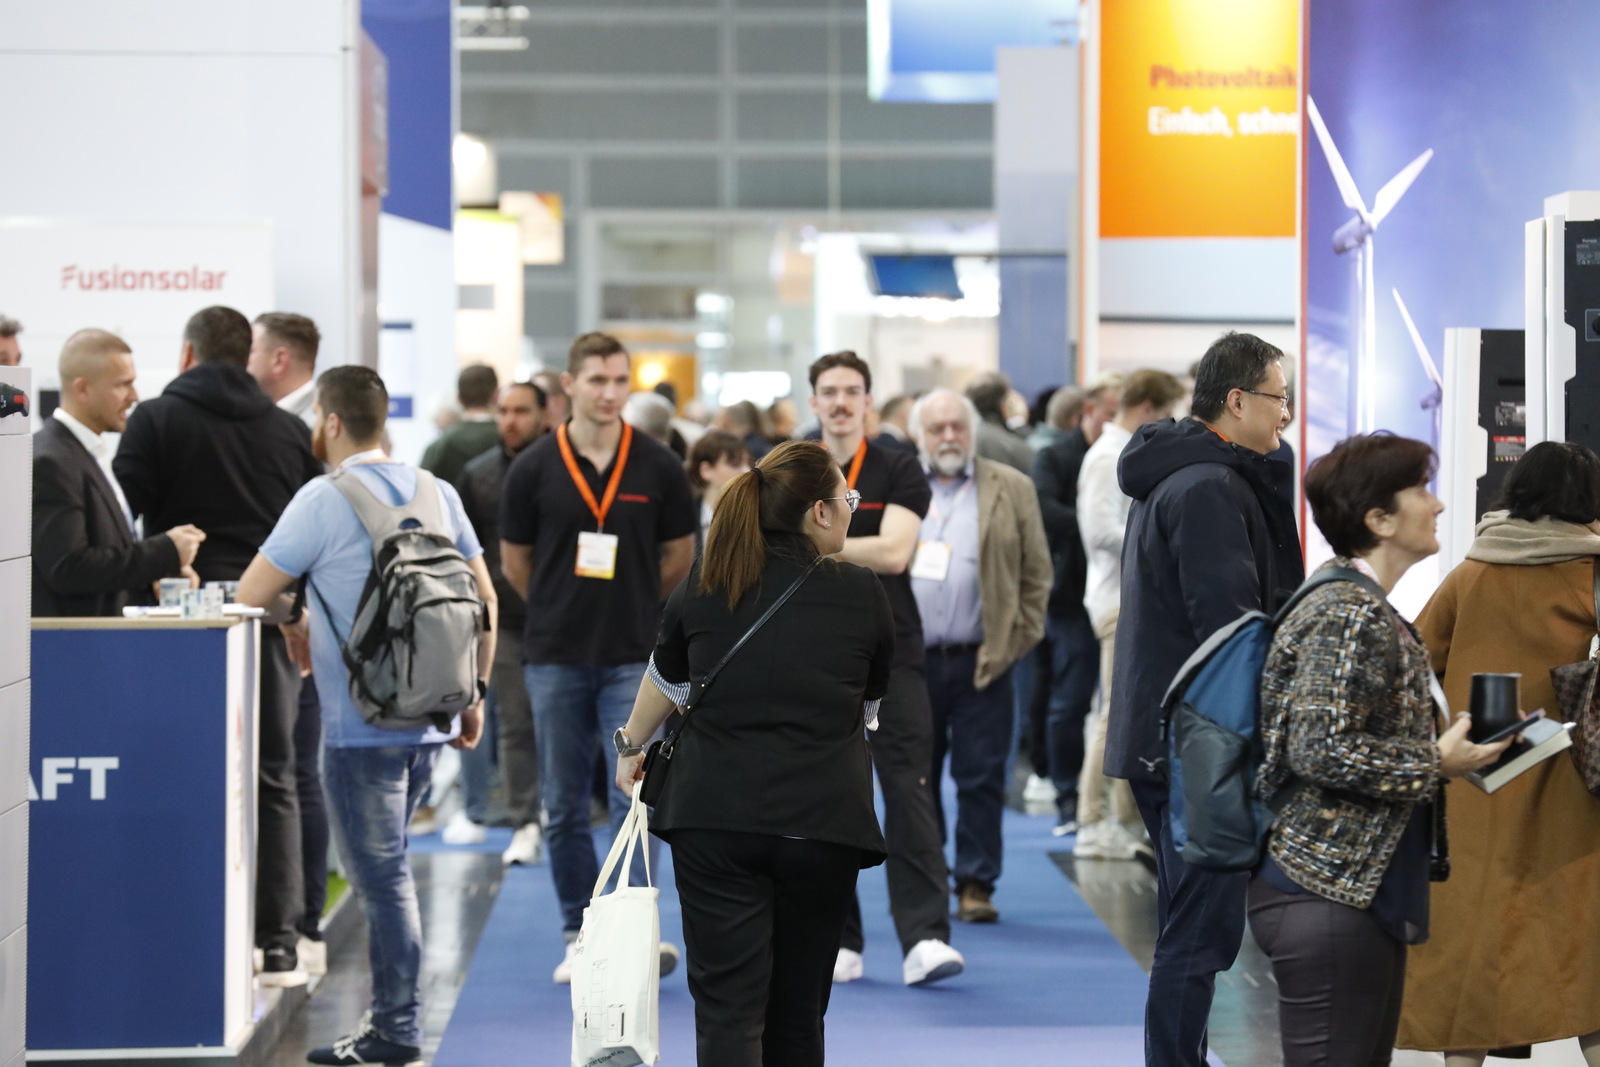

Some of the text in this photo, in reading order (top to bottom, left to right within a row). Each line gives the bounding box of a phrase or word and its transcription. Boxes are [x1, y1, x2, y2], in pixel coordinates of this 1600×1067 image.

[1150, 64, 1297, 89] Photovoltaik
[1148, 106, 1233, 137] Einfach,
[61, 264, 228, 291] Fusionsolar
